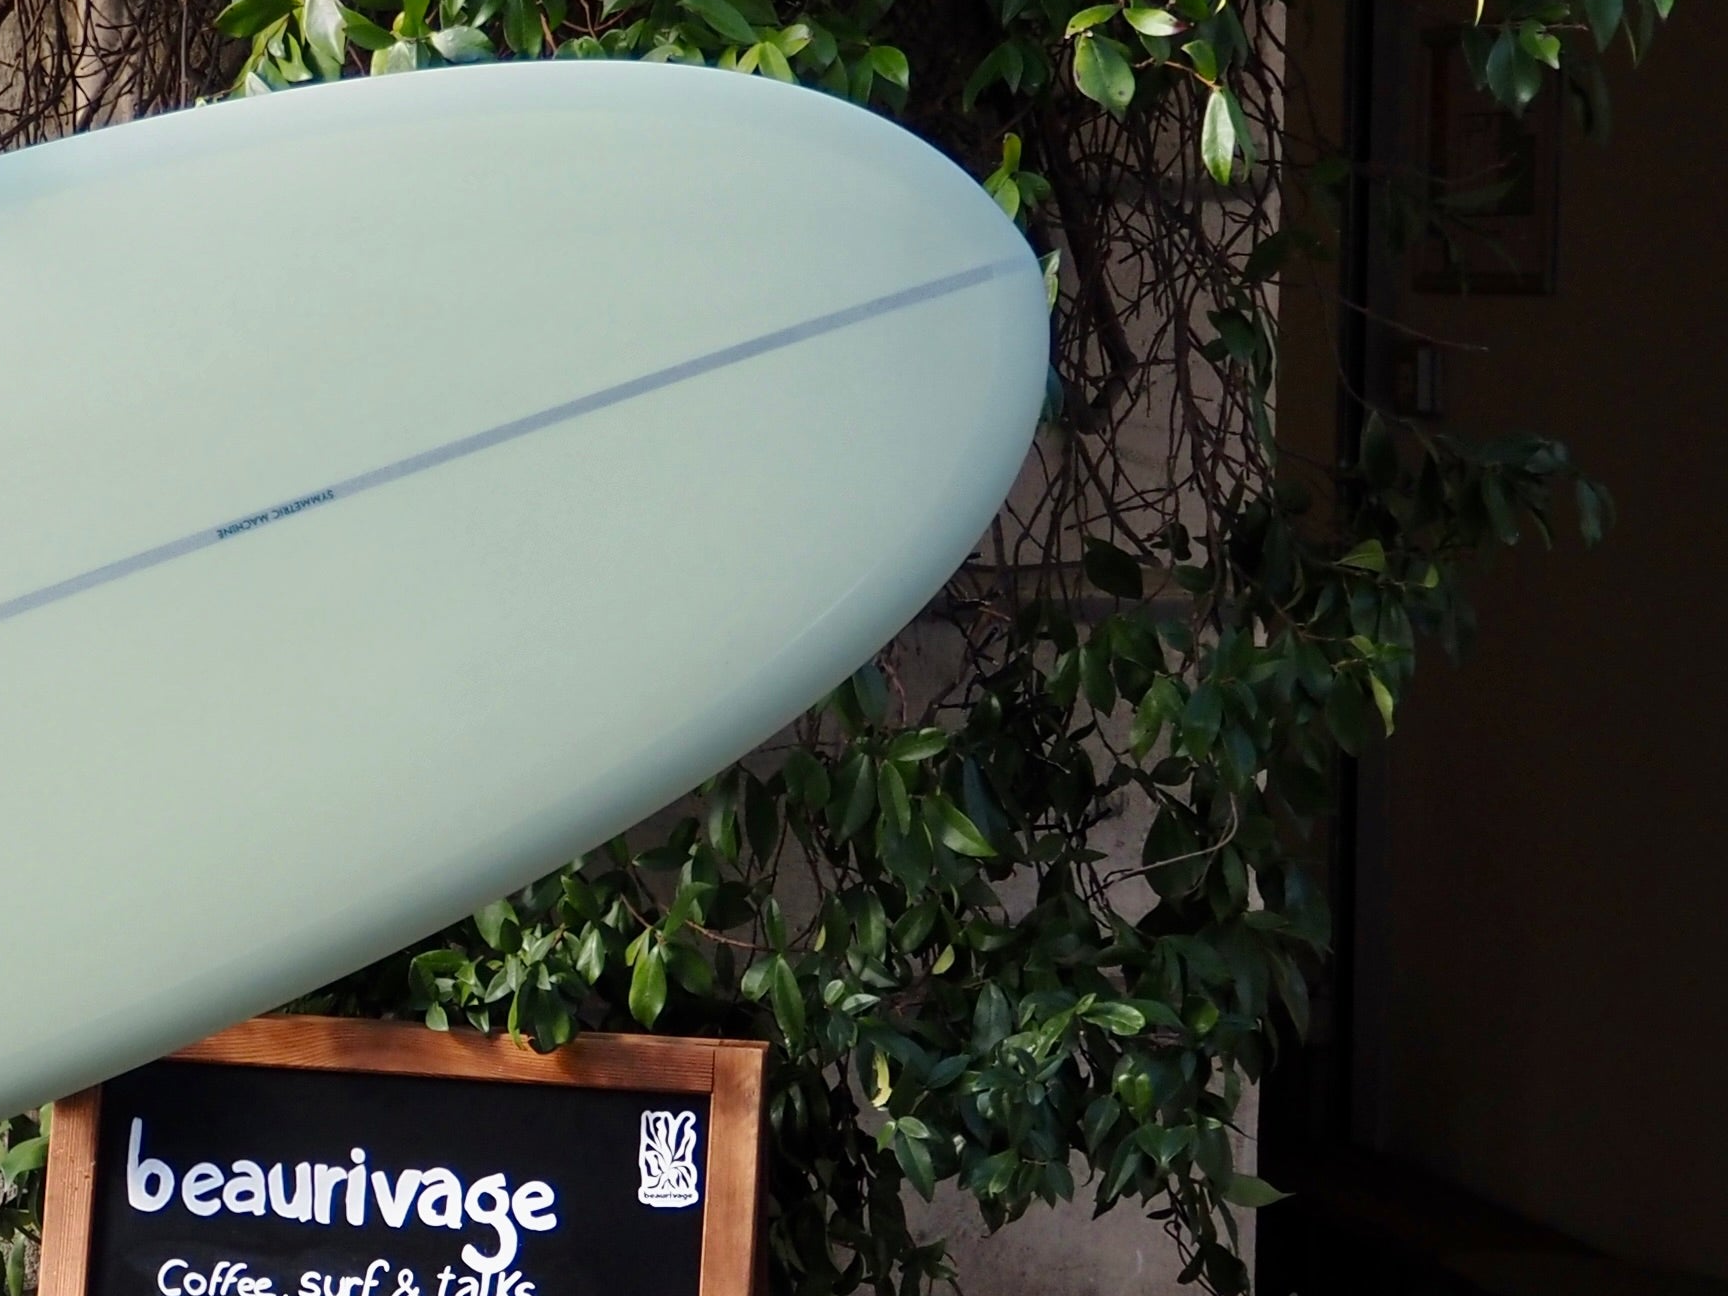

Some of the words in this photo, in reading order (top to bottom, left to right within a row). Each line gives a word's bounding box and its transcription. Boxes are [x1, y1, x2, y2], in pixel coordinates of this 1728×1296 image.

[272, 489, 334, 519] SYMMETRIC
[217, 513, 269, 539] MACHINE
[126, 1116, 559, 1274] beaurivage
[644, 1191, 692, 1200] beaurivage
